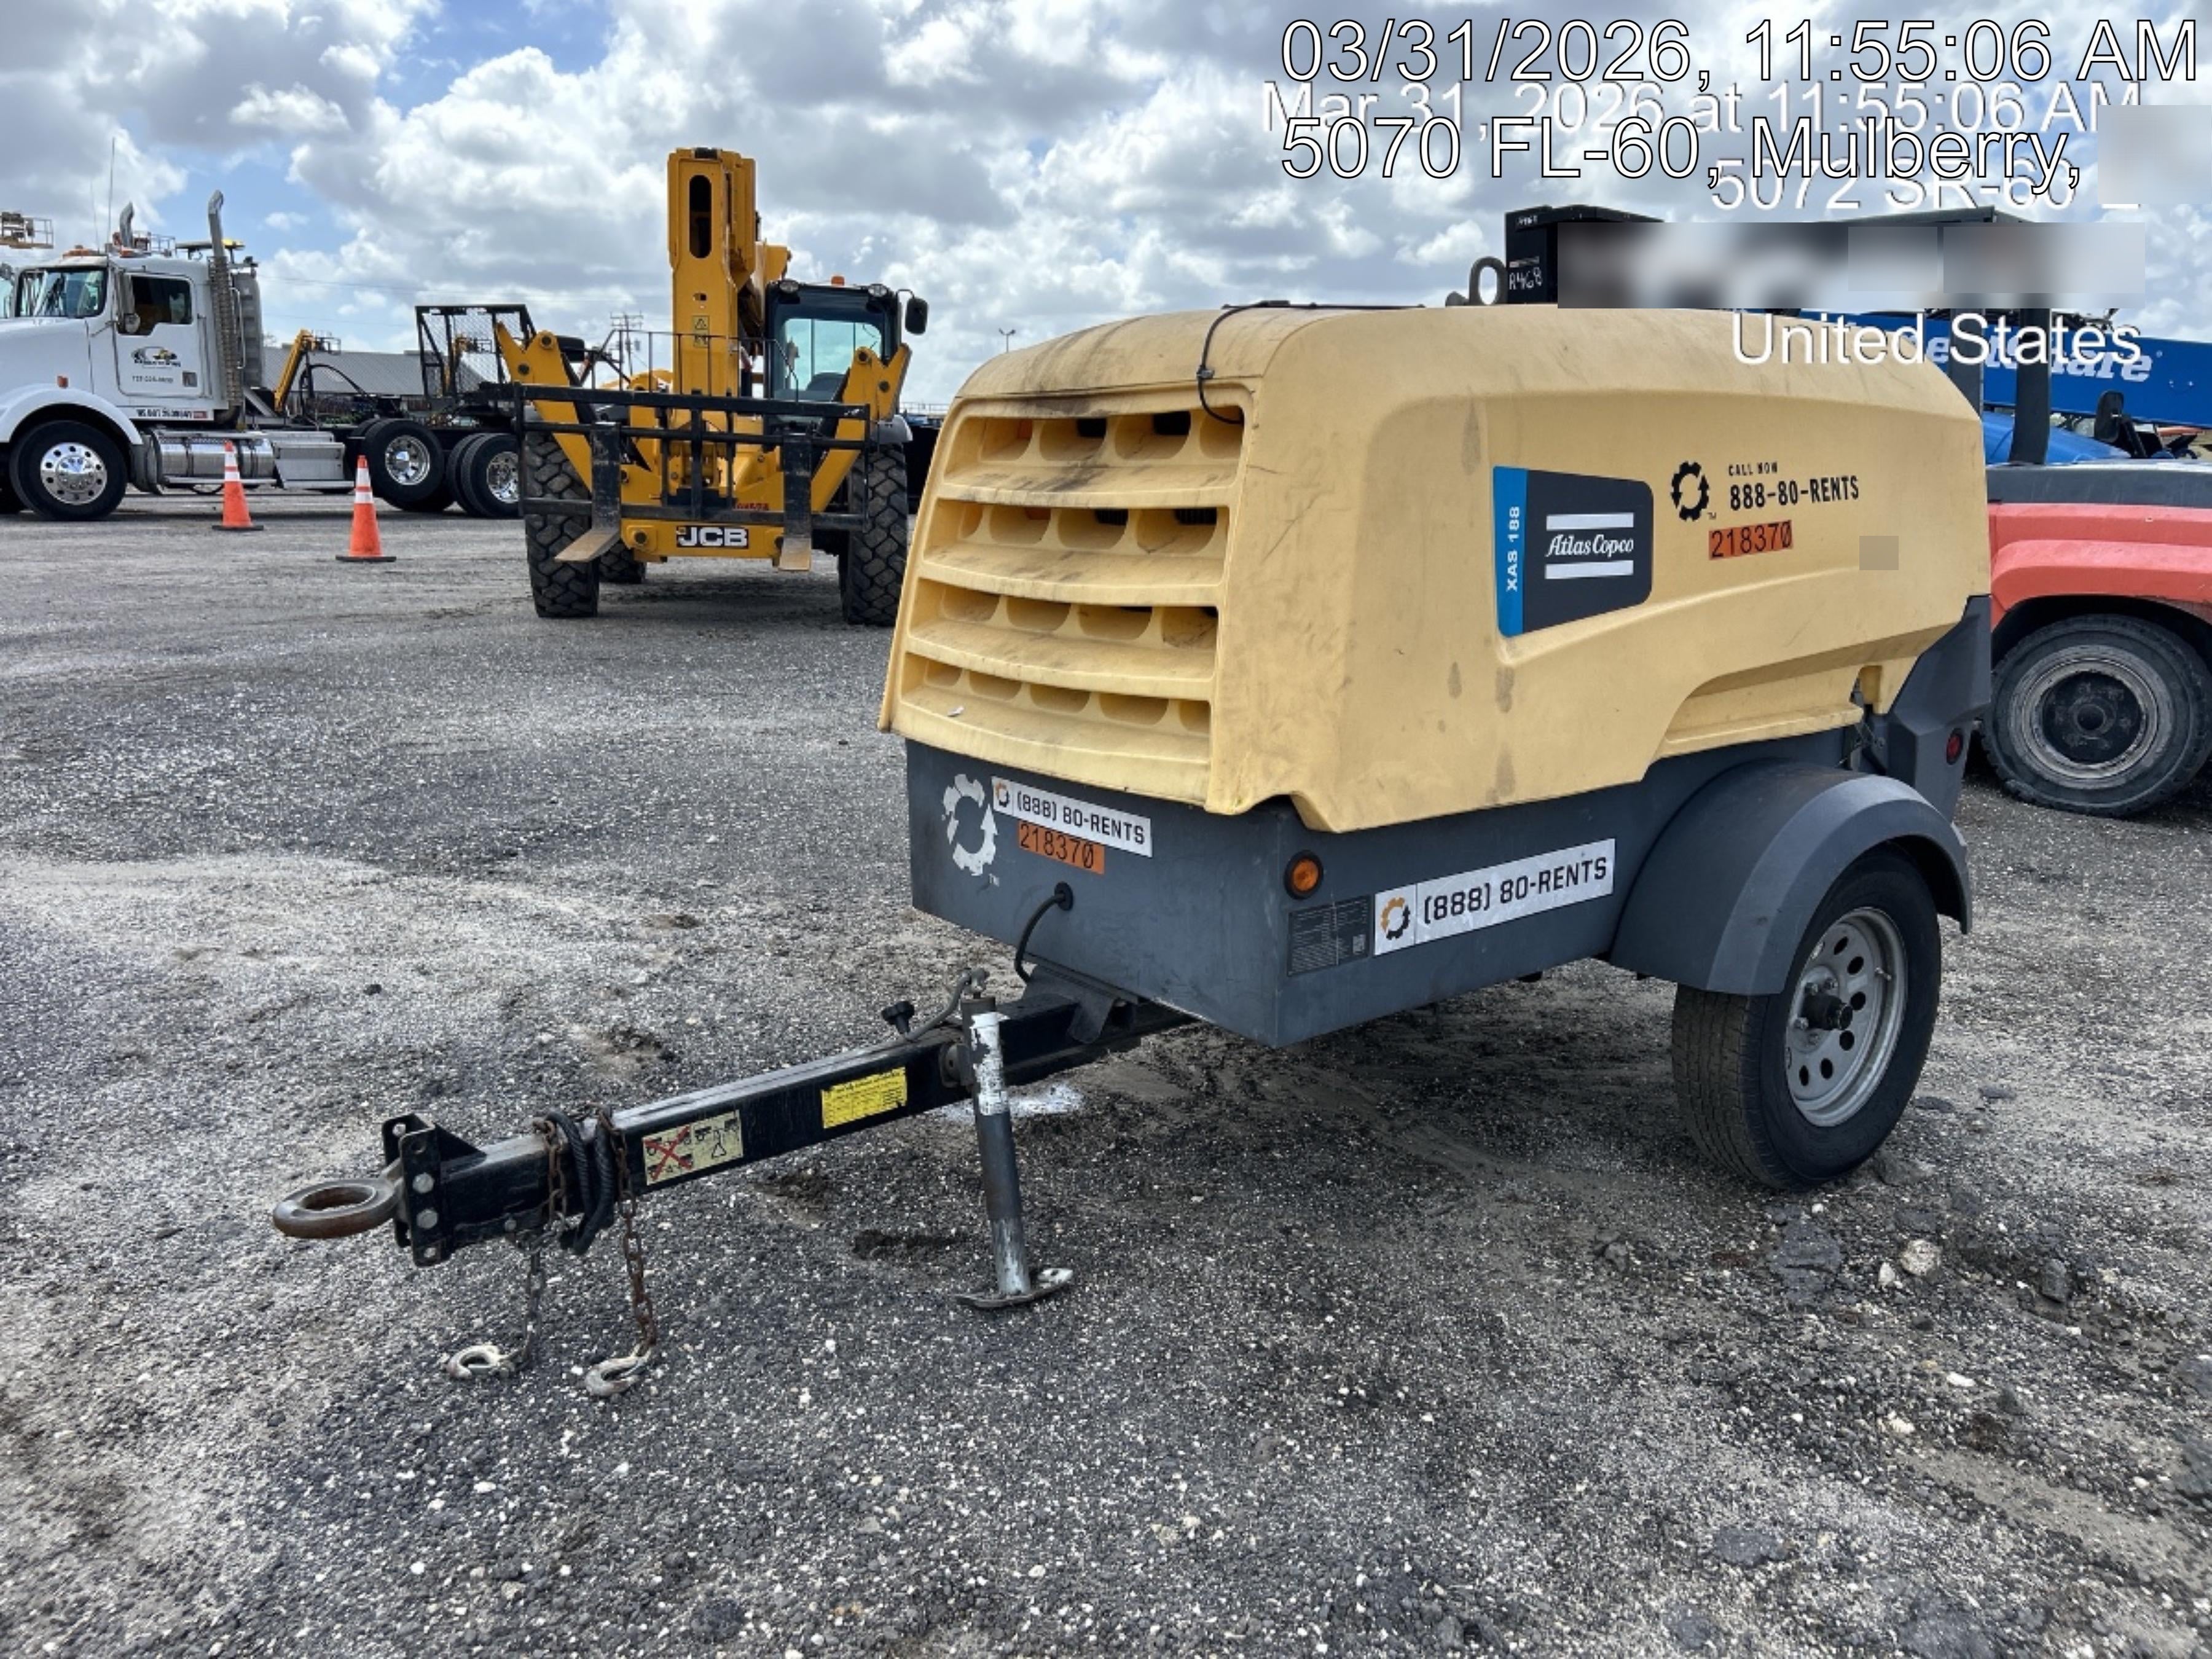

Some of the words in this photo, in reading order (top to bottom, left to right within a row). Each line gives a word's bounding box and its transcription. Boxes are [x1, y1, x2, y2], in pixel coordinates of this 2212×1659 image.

[1728, 464, 1753, 476] CALL
[1757, 461, 1778, 474] NOW
[1730, 475, 1859, 511] 888-80-RENTS
[678, 526, 747, 547] JCB
[1507, 506, 1520, 543] 188
[1711, 522, 1792, 557] 218370
[1544, 533, 1591, 557] Atlas
[1591, 533, 1634, 558] Copco
[1506, 550, 1518, 592] XAS
[1017, 791, 1056, 821] (888)
[1063, 806, 1145, 845] 80-RENTS
[1020, 823, 1094, 869] 218370
[1424, 882, 1490, 924] (888)
[1500, 857, 1607, 904] 80-RENTS
